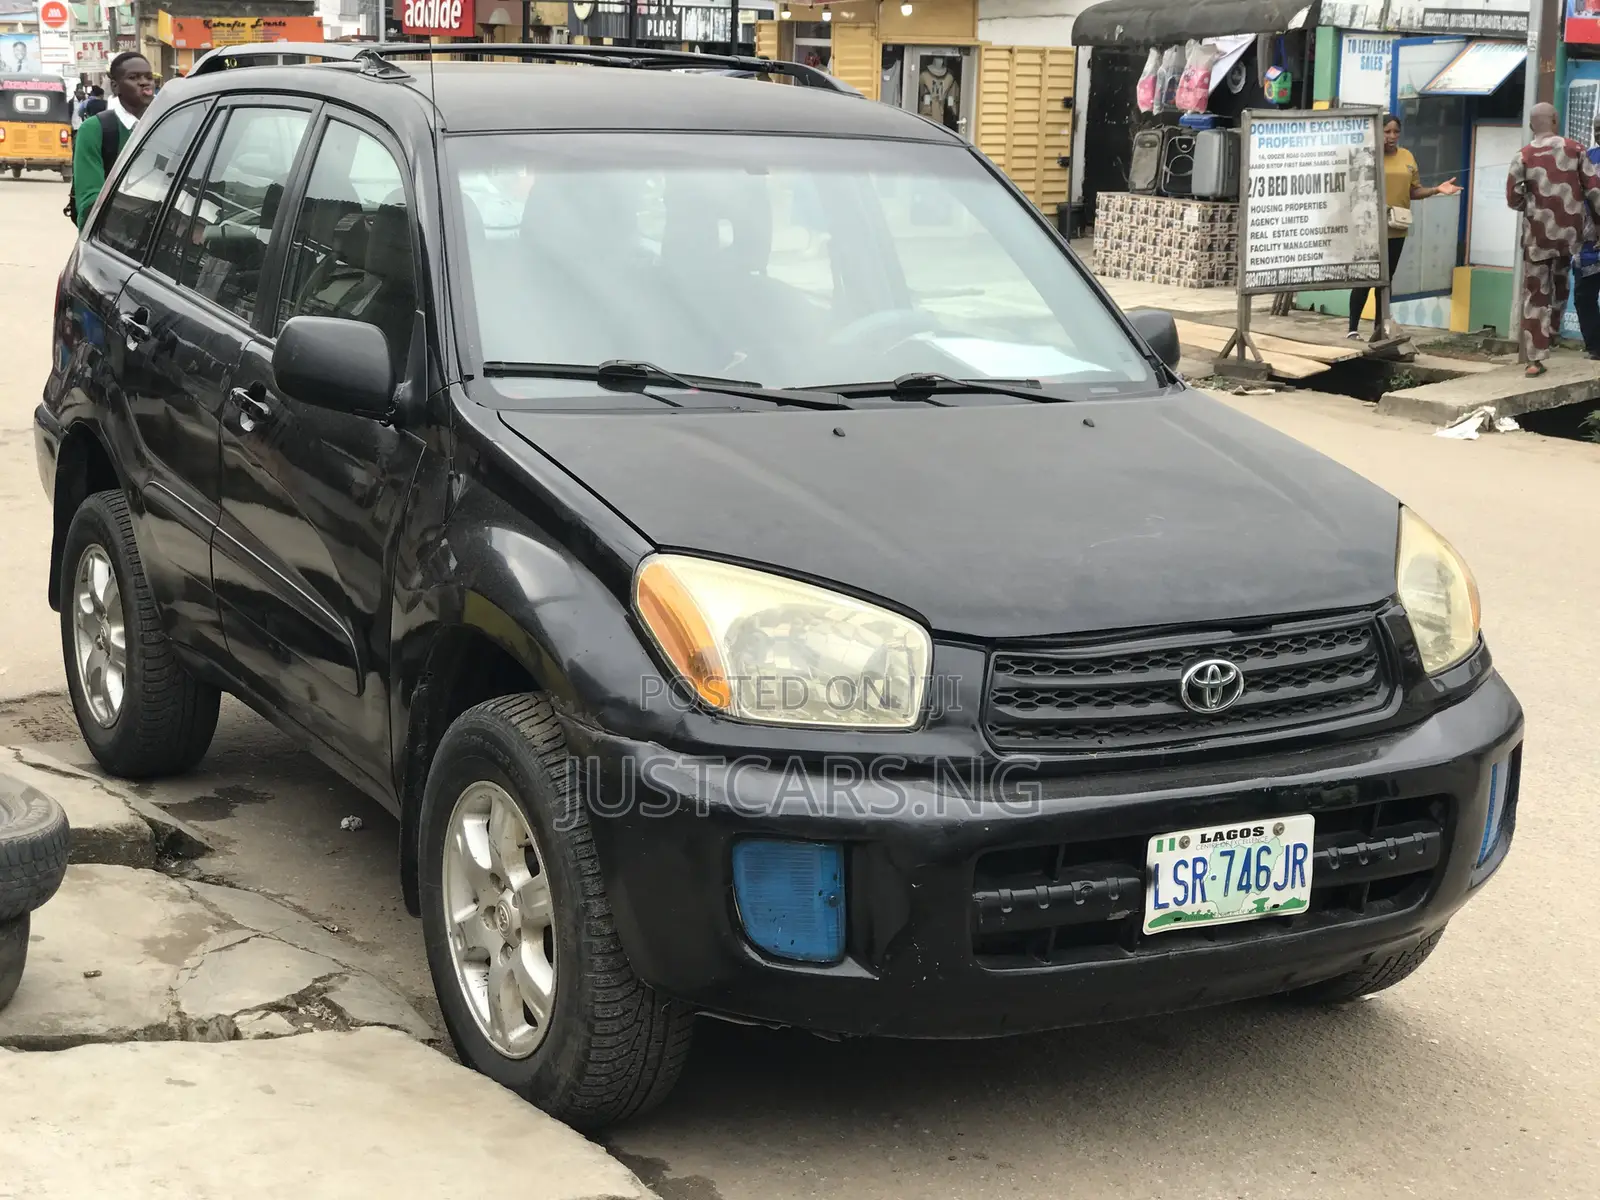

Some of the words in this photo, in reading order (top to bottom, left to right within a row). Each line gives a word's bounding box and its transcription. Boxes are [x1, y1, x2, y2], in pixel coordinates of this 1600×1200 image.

[647, 19, 677, 37] PLACE
[82, 42, 103, 51] EYE
[1360, 56, 1383, 71] SALES
[1250, 122, 1306, 135] DOMINION
[1310, 119, 1370, 133] EXCLUSIVE
[1258, 135, 1317, 149] PROPERTY
[1320, 132, 1365, 146] LIMITED
[1248, 175, 1265, 198] 2/3
[1268, 175, 1288, 197] BED
[1290, 173, 1321, 196] ROOM
[1324, 172, 1346, 193] FLAT
[1250, 203, 1283, 214] HOUSING
[1284, 201, 1328, 212] PROPERTIES
[1250, 217, 1279, 227] AGENCY
[1281, 215, 1309, 225] LIMITED
[1250, 230, 1268, 240] REAL
[1272, 228, 1298, 238] ESTATE
[1300, 225, 1348, 237] CONSULTANTS
[1250, 243, 1281, 253] FACILITY
[1283, 239, 1332, 251] MANAGEMENT
[1250, 254, 1296, 266] RENOVATION
[1297, 252, 1324, 262] DESIGN
[1200, 826, 1265, 844] LAGOS
